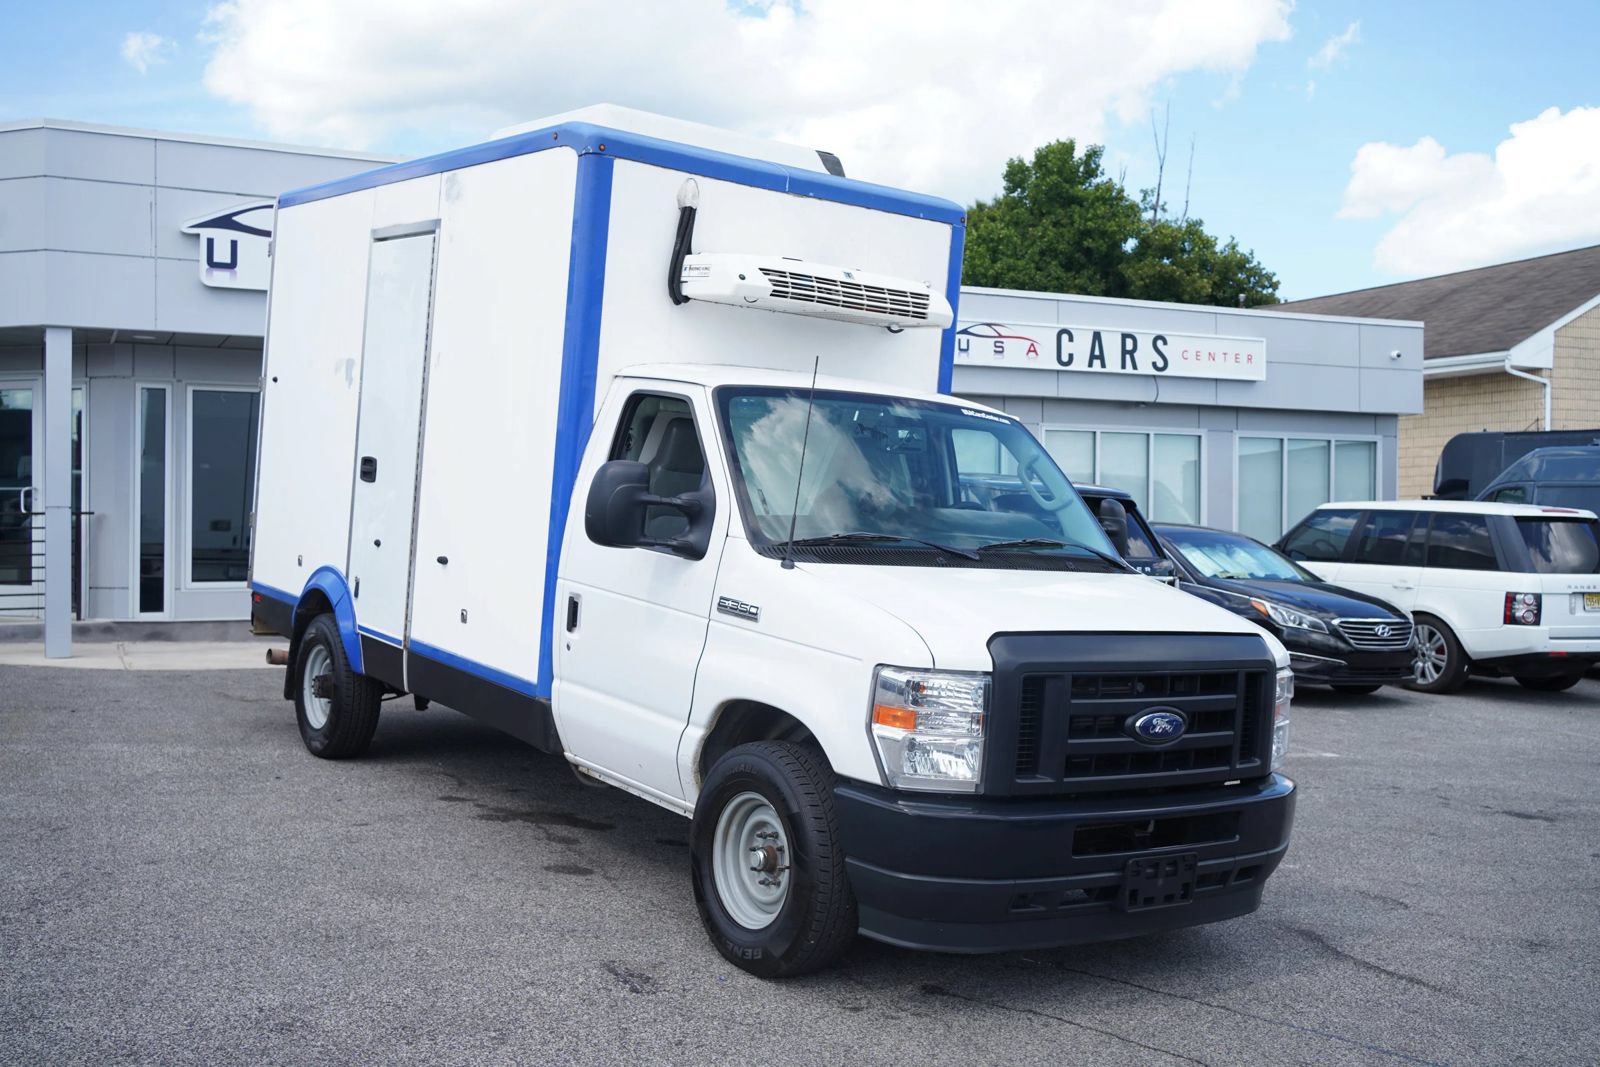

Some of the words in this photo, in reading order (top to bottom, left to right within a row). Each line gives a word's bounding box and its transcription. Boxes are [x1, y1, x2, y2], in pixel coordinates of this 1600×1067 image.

[958, 338, 1039, 356] USA
[1056, 328, 1169, 373] CARS
[1181, 349, 1254, 365] CENTER
[1149, 717, 1176, 734] Ford
